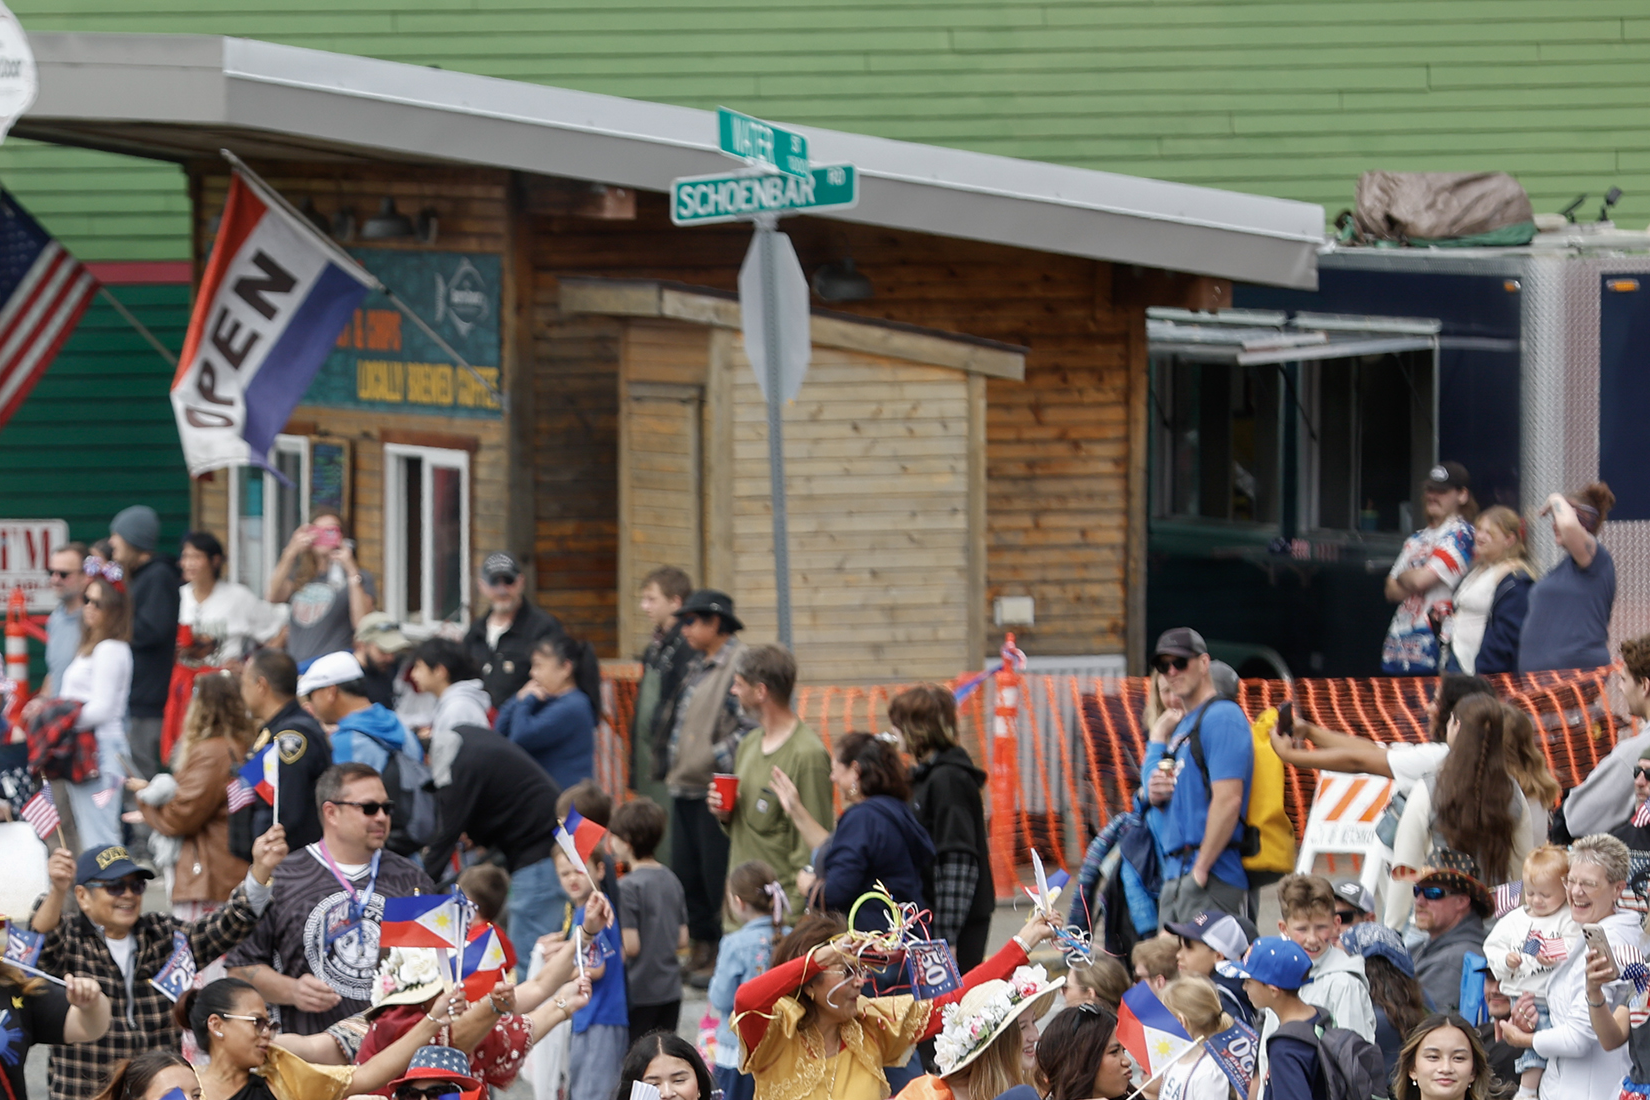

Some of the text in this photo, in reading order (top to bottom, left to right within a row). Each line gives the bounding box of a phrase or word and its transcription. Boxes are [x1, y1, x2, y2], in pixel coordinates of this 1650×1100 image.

[677, 166, 847, 218] SCHOENBAR RD
[185, 249, 299, 428] OPEN
[357, 359, 405, 402] LOCALLY
[406, 361, 455, 407] BREWED
